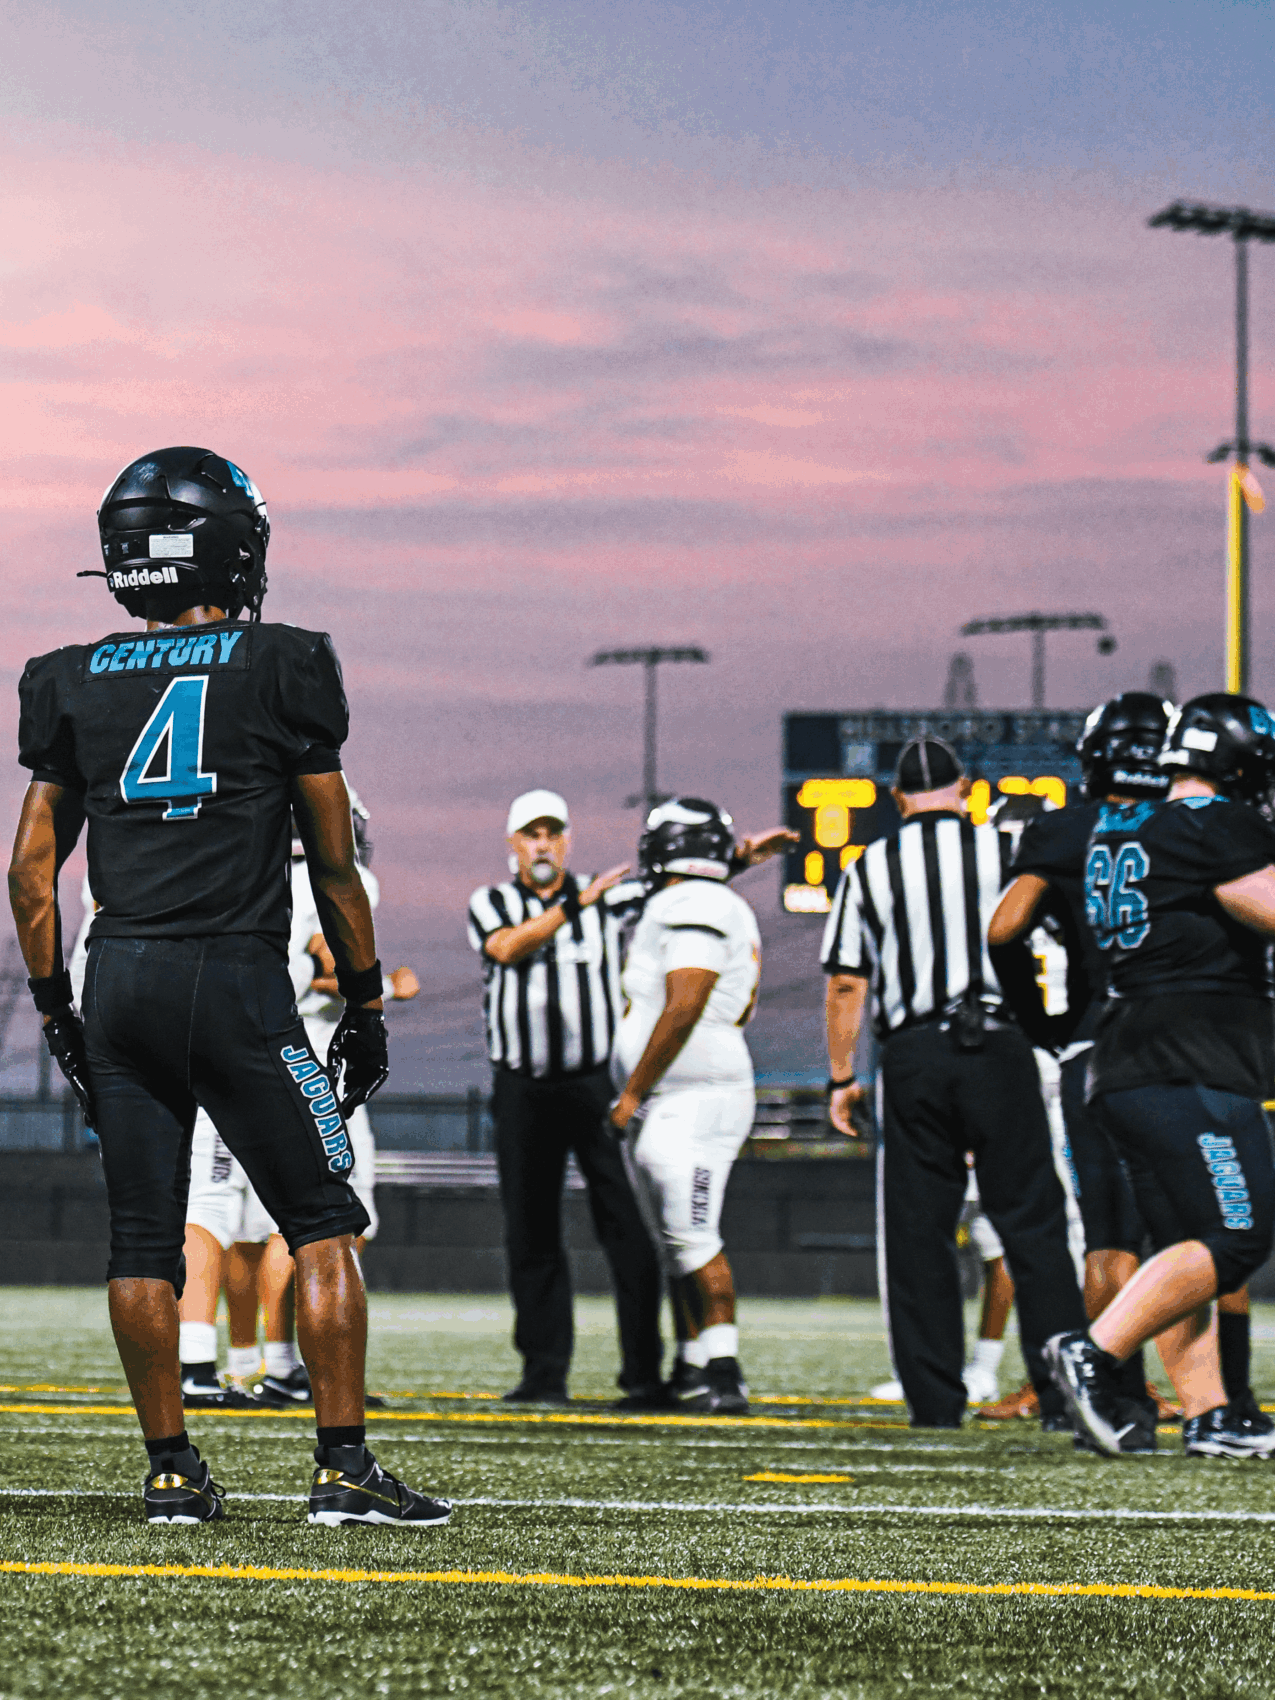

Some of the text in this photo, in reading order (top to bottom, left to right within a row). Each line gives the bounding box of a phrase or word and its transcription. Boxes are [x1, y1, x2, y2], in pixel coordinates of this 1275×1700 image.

[113, 567, 178, 589] Riddell
[89, 631, 243, 674] CENTURY
[119, 675, 217, 821] 4
[1085, 841, 1151, 949] 66
[280, 1045, 353, 1173] JAGUARS
[691, 1166, 711, 1230] VIKINGS
[1197, 1132, 1254, 1230] JAGUARS
